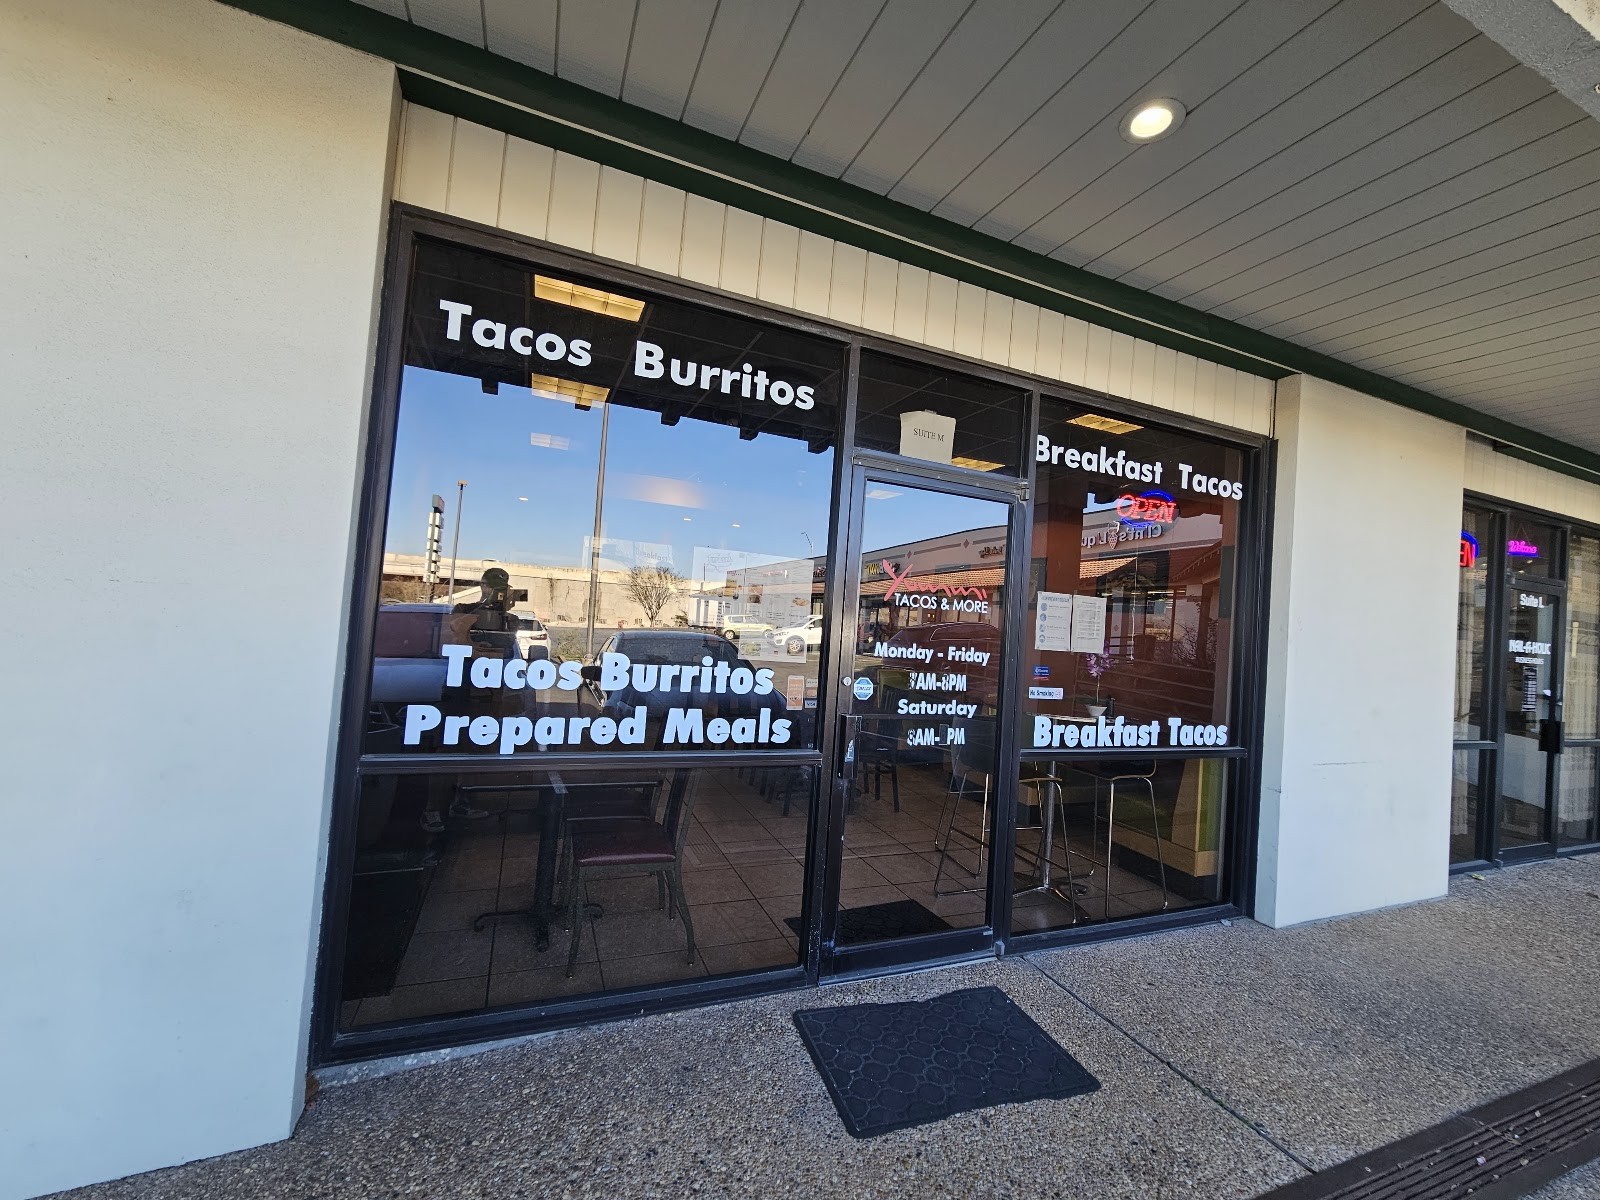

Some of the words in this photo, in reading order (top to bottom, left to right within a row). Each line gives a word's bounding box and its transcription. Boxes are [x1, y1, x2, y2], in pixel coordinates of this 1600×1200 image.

[439, 299, 592, 367] Tacos
[634, 340, 816, 411] Burritos
[913, 427, 936, 440] SUITE
[937, 433, 945, 442] M
[1036, 435, 1163, 485] Breakfast
[1179, 463, 1244, 501] Tacos
[1116, 494, 1177, 524] OPEN
[894, 592, 938, 611] TACOS
[941, 597, 950, 611] &
[953, 599, 989, 614] MORE
[1519, 593, 1538, 608] Suite
[442, 643, 584, 692] Tacos
[600, 652, 775, 695] Burritos
[874, 642, 934, 663] Monday
[947, 646, 991, 667] Friday
[898, 698, 978, 719] Saturday
[404, 704, 647, 756] Prepared
[663, 707, 792, 745] Meals
[1034, 716, 1161, 748] Breakfast
[1168, 717, 1229, 747] Tacos
